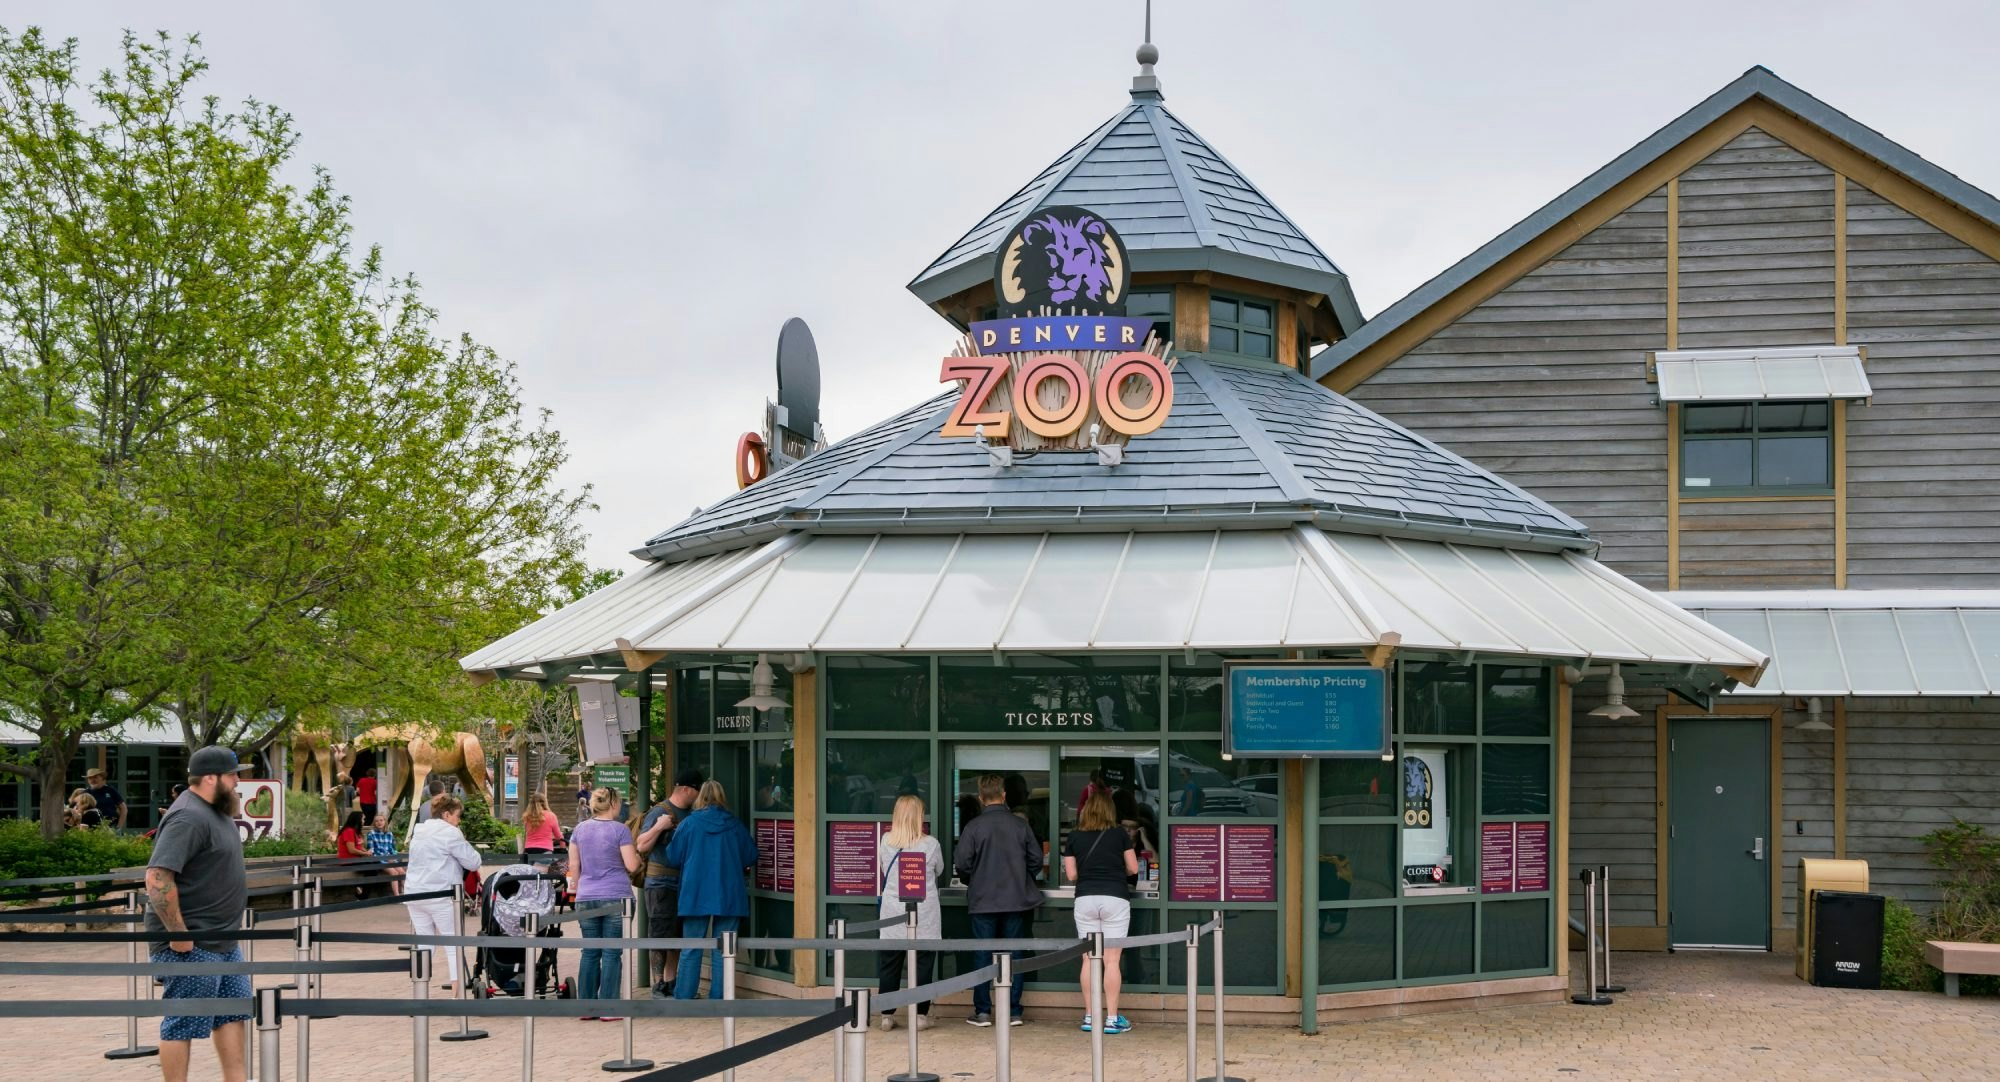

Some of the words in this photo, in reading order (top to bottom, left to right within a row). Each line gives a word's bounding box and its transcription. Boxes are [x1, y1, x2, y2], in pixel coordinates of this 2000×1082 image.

[983, 325, 1135, 347] DENVER
[939, 351, 1174, 438] ZOO
[1246, 676, 1321, 688] Membership
[1323, 676, 1367, 688] Pricing
[716, 715, 751, 729] TICKETS
[1005, 713, 1093, 726] TICKETS
[1246, 715, 1265, 723] Family
[1404, 810, 1430, 825] OO
[1407, 868, 1433, 876] CLOSED
[1835, 961, 1861, 969] ARROW
